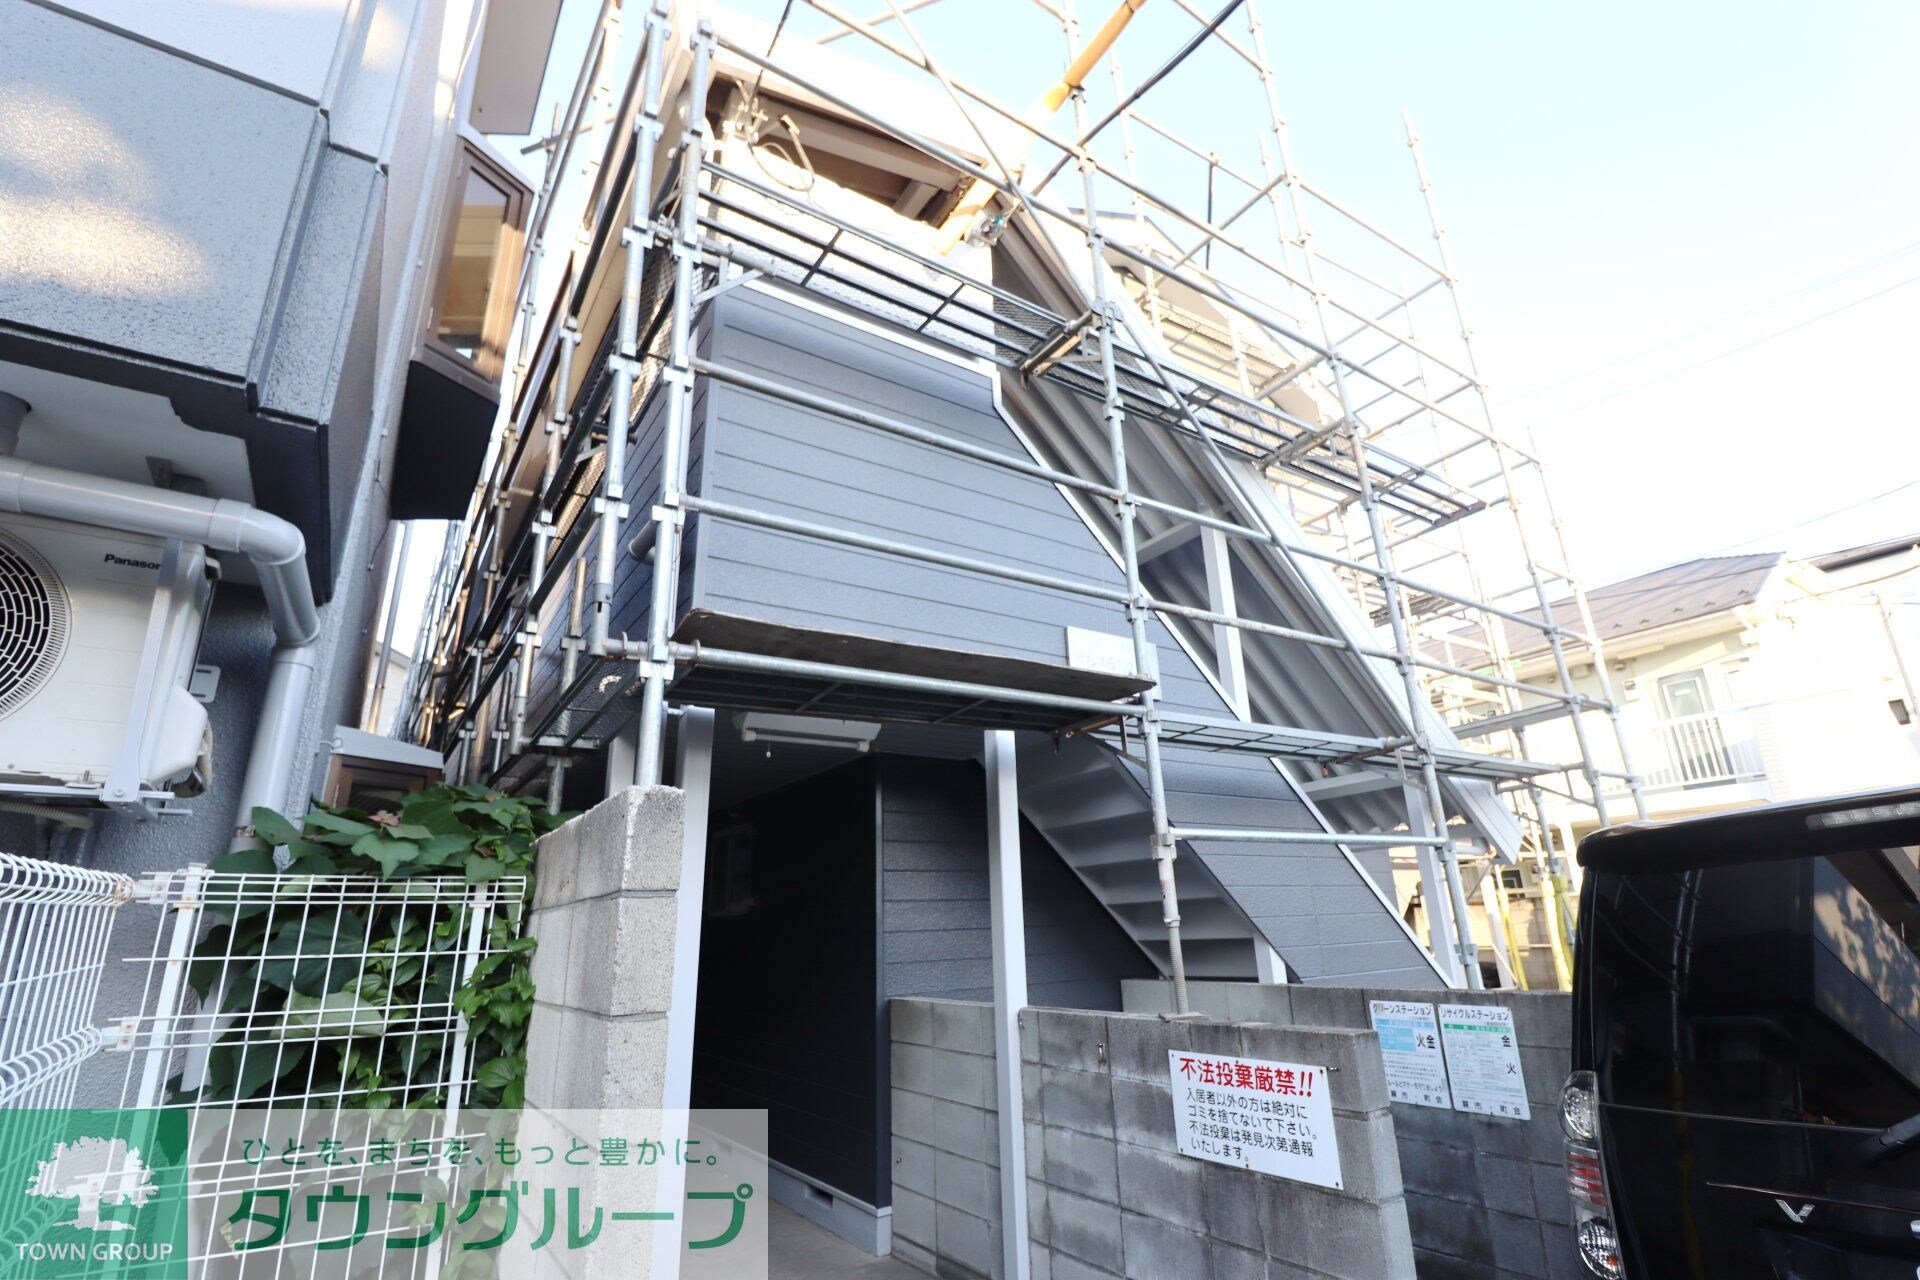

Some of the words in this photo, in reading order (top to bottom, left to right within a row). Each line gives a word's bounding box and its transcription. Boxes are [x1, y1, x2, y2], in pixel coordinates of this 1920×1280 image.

[1441, 1008, 1509, 1021] リサイクルステーション
[1501, 1035, 1512, 1048] 金
[1180, 1057, 1313, 1097] 不法投棄厳禁!!
[1506, 1062, 1517, 1075] 火
[1186, 1087, 1308, 1119] 入居者以外の方は絶対に
[1188, 1104, 1317, 1140] ゴミを捨てないで下さい。
[1189, 1120, 1314, 1157] 不法投棄は発見次第通報
[1192, 1136, 1249, 1162] いたします。
